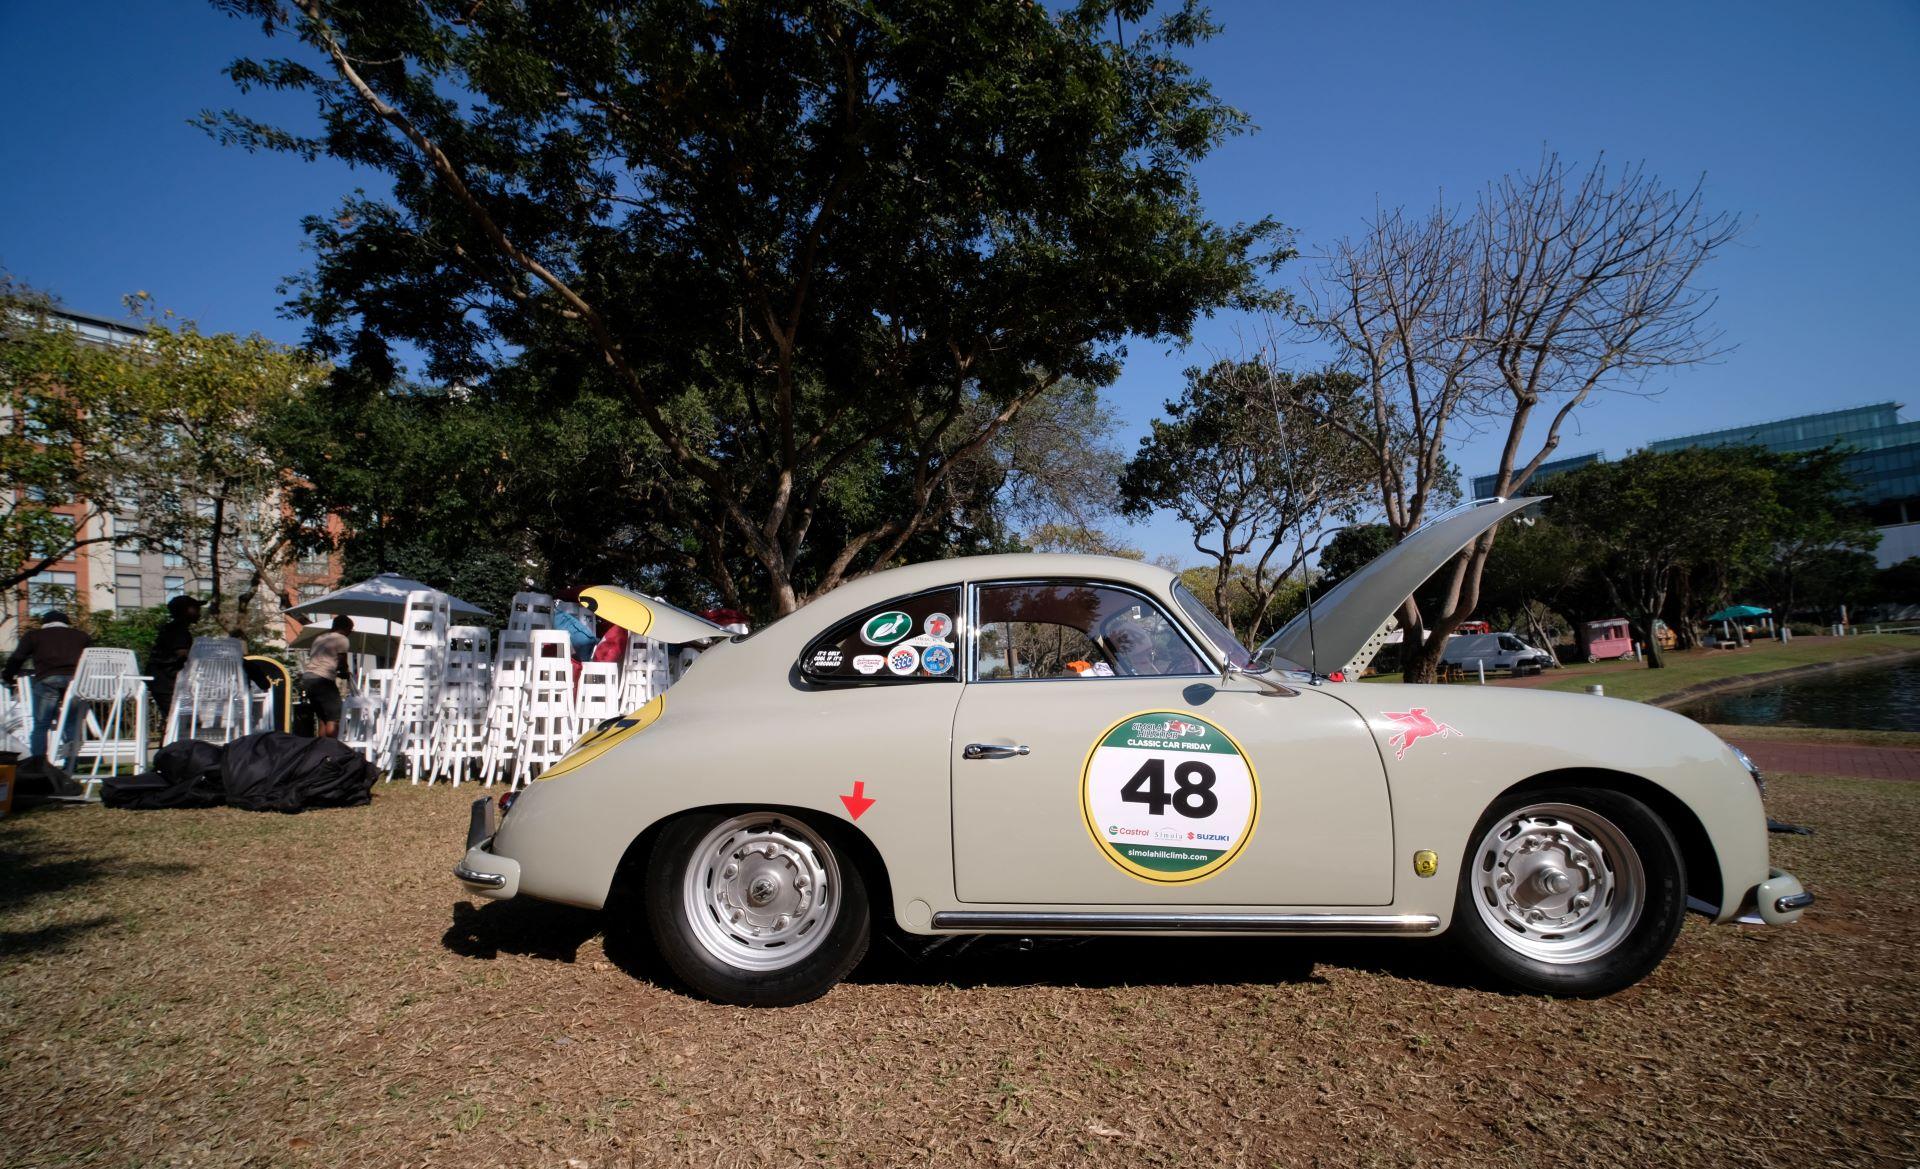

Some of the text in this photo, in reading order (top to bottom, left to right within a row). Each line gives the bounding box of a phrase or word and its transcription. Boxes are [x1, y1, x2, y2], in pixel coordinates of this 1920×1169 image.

[896, 656, 912, 669] SCC
[1127, 739, 1212, 751] CLASSIC CAR FRIDAY
[1120, 758, 1219, 819] 48
[1119, 827, 1150, 837] Castrol
[1196, 833, 1230, 842] SUZUKI
[1128, 849, 1208, 861] simolahillclimb.com
